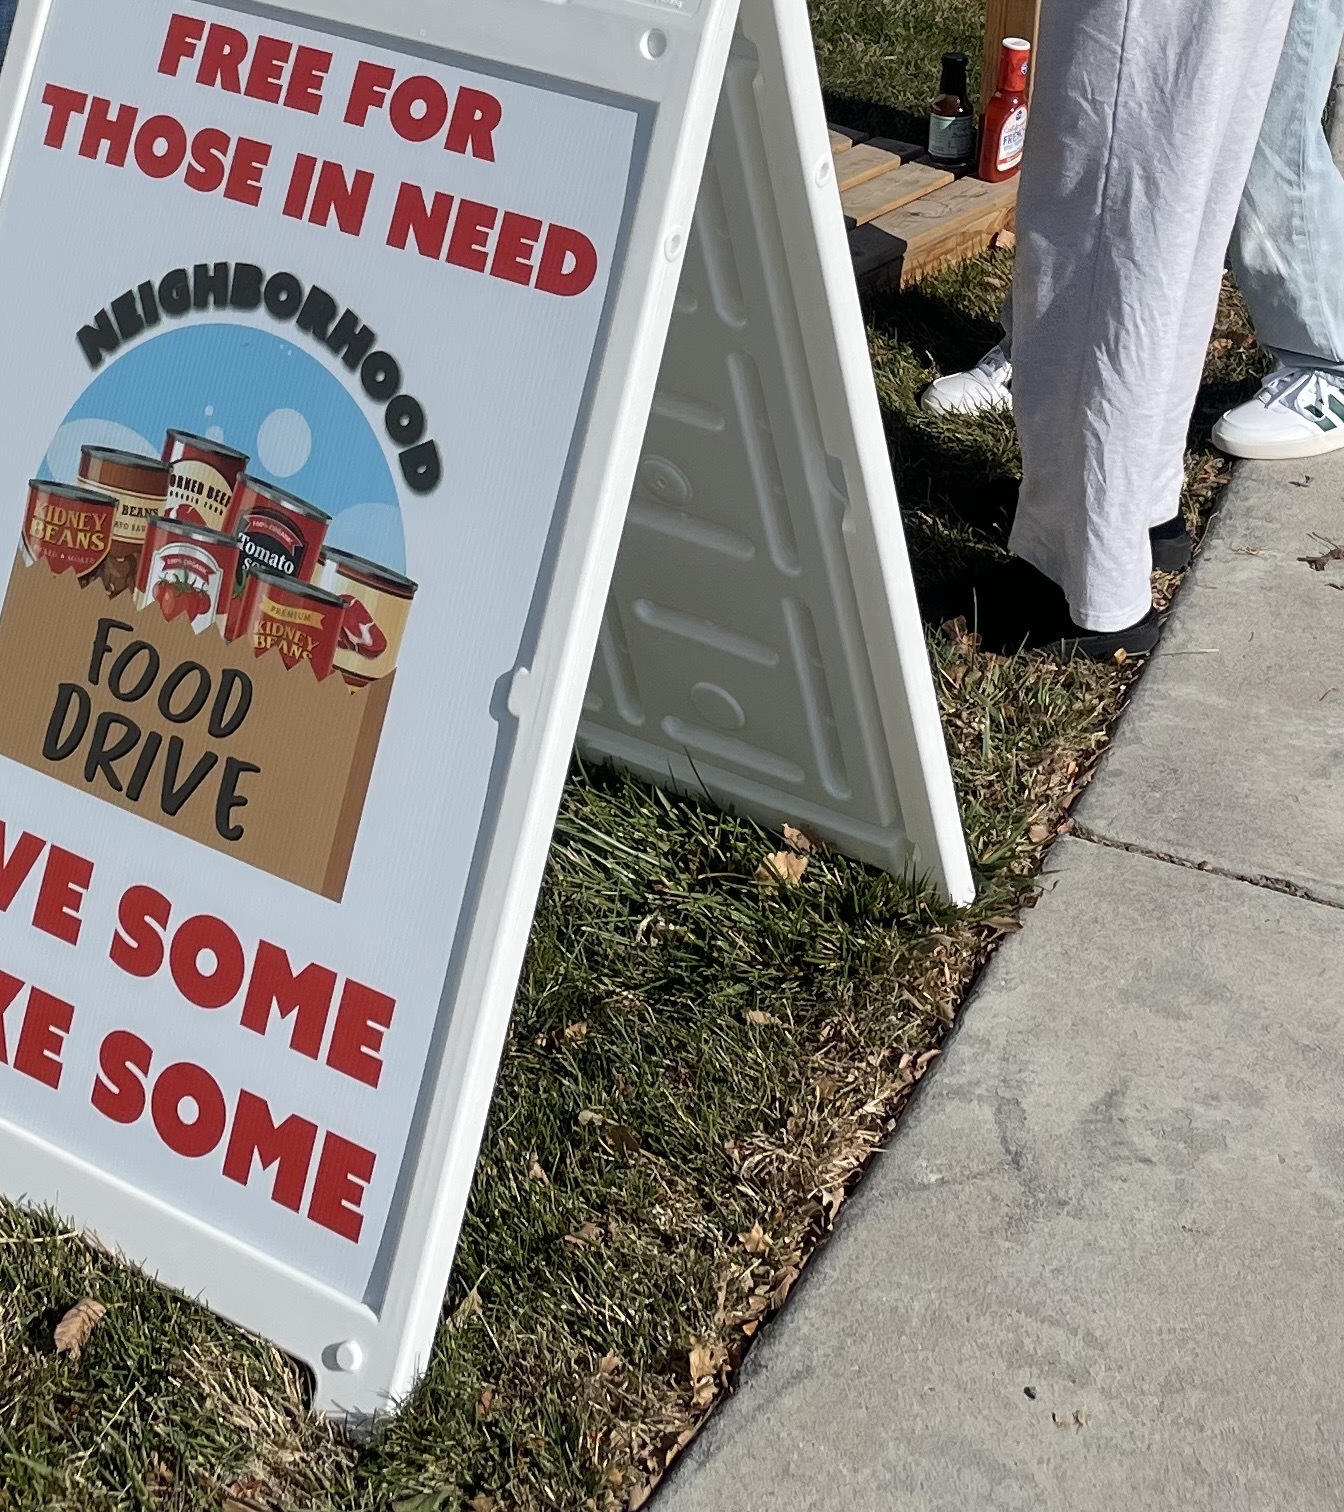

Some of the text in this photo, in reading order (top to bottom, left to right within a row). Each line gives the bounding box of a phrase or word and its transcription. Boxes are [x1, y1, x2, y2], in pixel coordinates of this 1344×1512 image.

[157, 13, 503, 163] FREE FOR
[40, 83, 598, 297] THOSE IN NEED
[76, 262, 442, 495] NEIGHBORHOOD
[33, 499, 106, 532] KIDNEY
[121, 504, 159, 518] BEANS
[169, 473, 205, 496] ORNED
[29, 517, 106, 552] BEANS
[238, 532, 295, 575] Tomato
[254, 620, 320, 651] KIDNEY
[269, 604, 313, 621] PREMIUM
[88, 618, 254, 739] FOOD
[42, 682, 262, 842] DRIVE
[109, 884, 398, 1090] SOME
[90, 1029, 377, 1244] SOME
